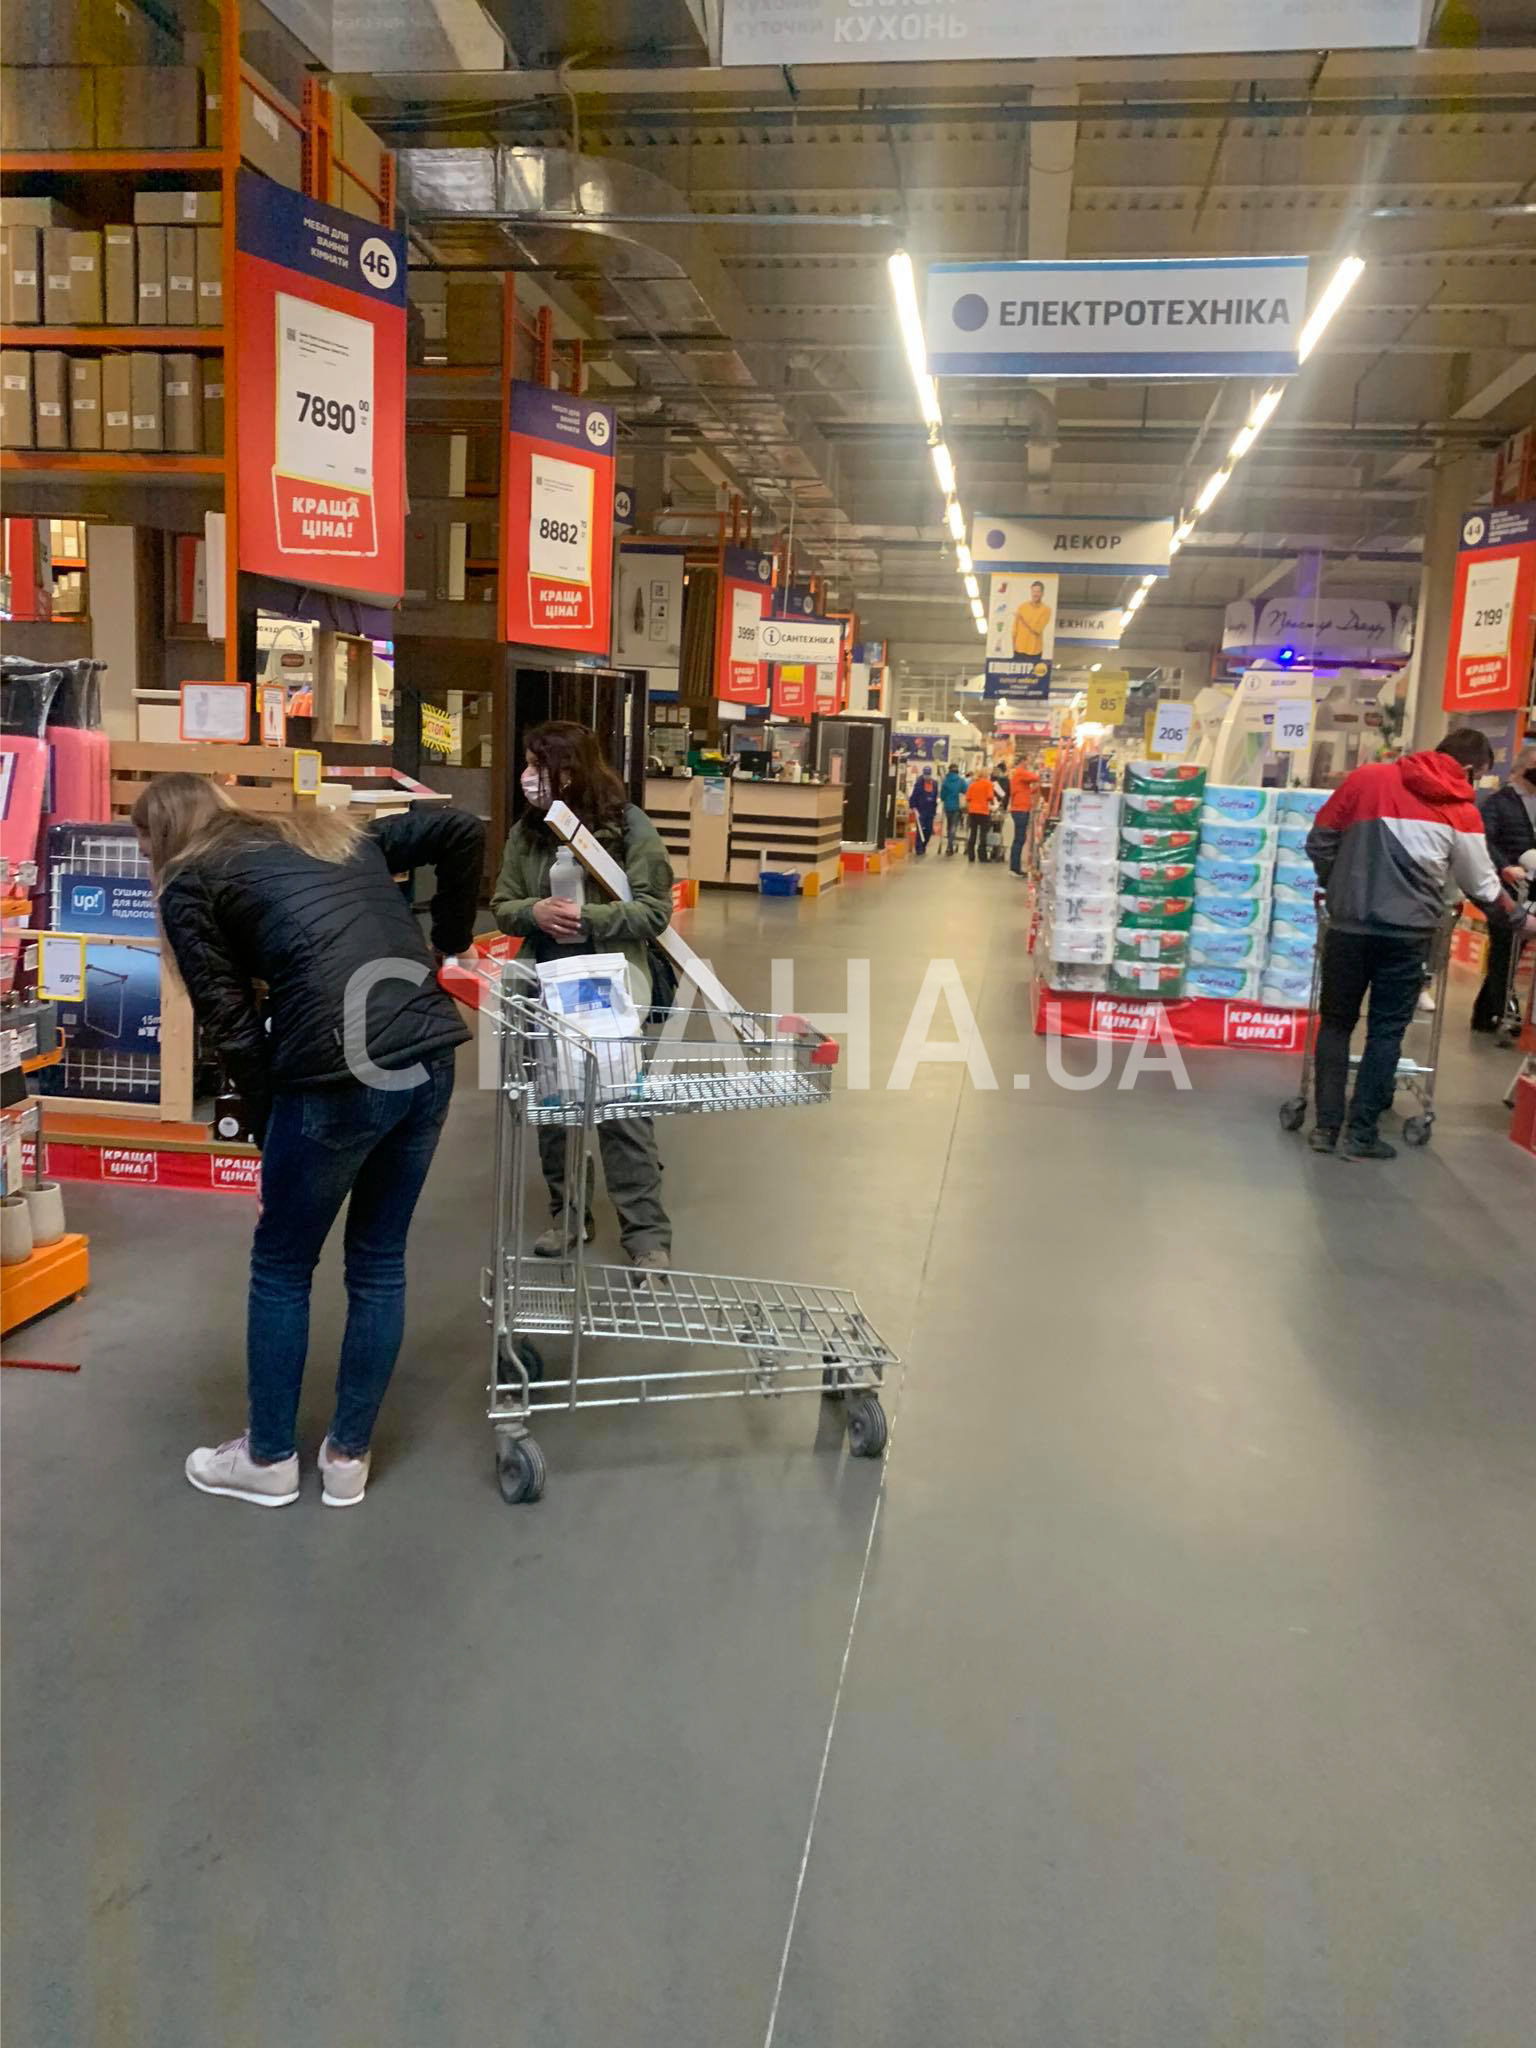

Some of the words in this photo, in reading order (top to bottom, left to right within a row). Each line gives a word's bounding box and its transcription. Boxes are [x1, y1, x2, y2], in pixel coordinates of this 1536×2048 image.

[834, 14, 968, 44] КУХОНЬ
[363, 250, 390, 278] 46
[1000, 298, 1291, 326] ЕЛЕКТРОТЕХНІКА
[296, 390, 356, 435] 7890
[588, 420, 605, 437] 45
[292, 496, 360, 520] КРАЩА
[302, 519, 353, 539] ЦІНА!
[540, 518, 578, 545] 8882
[1466, 522, 1482, 537] 44
[1053, 534, 1122, 551] ДЕКОР
[540, 590, 583, 605] КРАЩА
[545, 605, 579, 619] ЦІНА!
[1474, 608, 1503, 627] 2199
[1055, 620, 1105, 630] ЕХНІКА
[782, 633, 835, 645] САНТЕХНІКА
[1465, 661, 1502, 677] КРАЩА
[1101, 698, 1117, 711] 85
[1159, 727, 1183, 741] 206
[1282, 724, 1304, 737] 178
[112, 888, 153, 898] СУШАРКА
[74, 890, 104, 912] up!
[112, 899, 132, 908] ДЛЯ
[112, 909, 156, 920] ПІДЛОГОВ
[1096, 1000, 1157, 1017] КРАЩА
[1101, 1015, 1147, 1030] ЦІНА!
[1228, 1011, 1292, 1026] КРАЩА
[1236, 1024, 1285, 1040] ЦІНА!
[105, 1150, 153, 1163] КРАЩА
[111, 1162, 148, 1175] ЦІНА!
[221, 1169, 258, 1182] ЦІНА!
